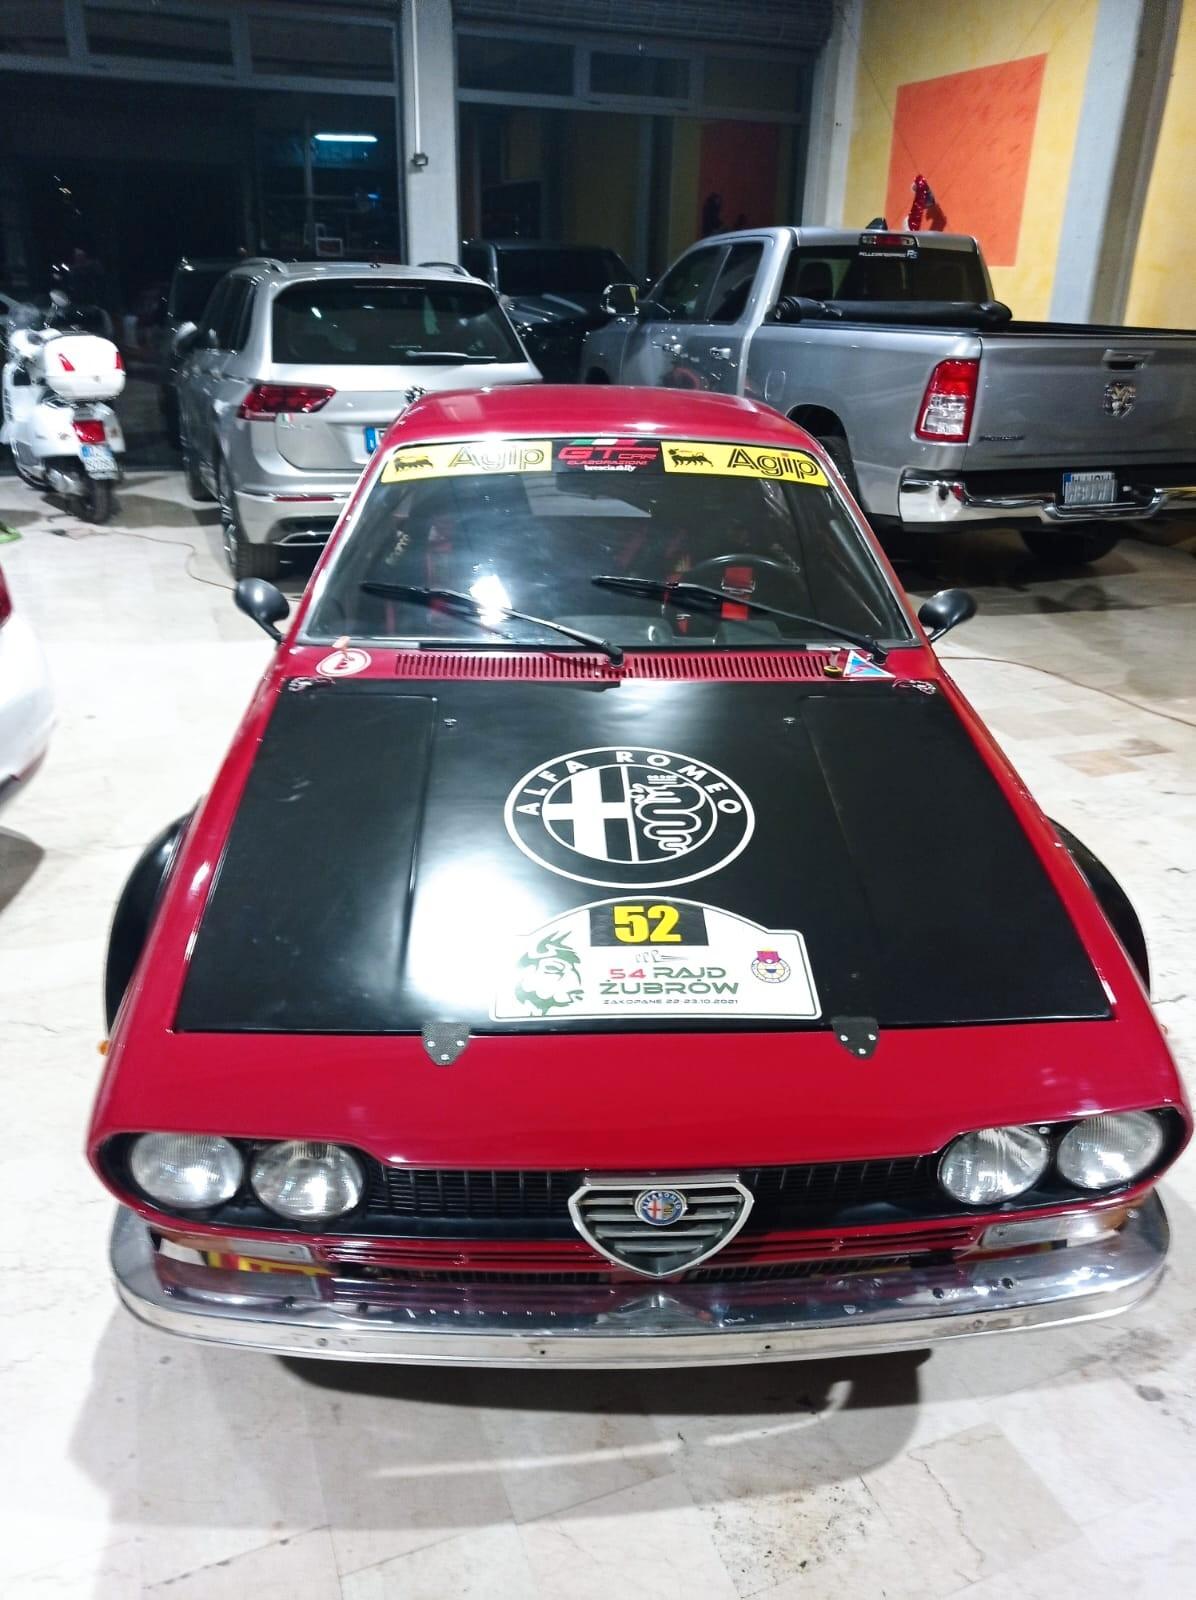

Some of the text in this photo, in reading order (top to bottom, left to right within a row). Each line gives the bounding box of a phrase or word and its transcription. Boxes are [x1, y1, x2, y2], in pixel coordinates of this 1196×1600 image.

[448, 446, 545, 471] Agip
[727, 448, 819, 479] Agip
[516, 751, 742, 816] ALFA ROMEO
[613, 904, 682, 943] 52
[610, 967, 727, 979] 54 RAJD
